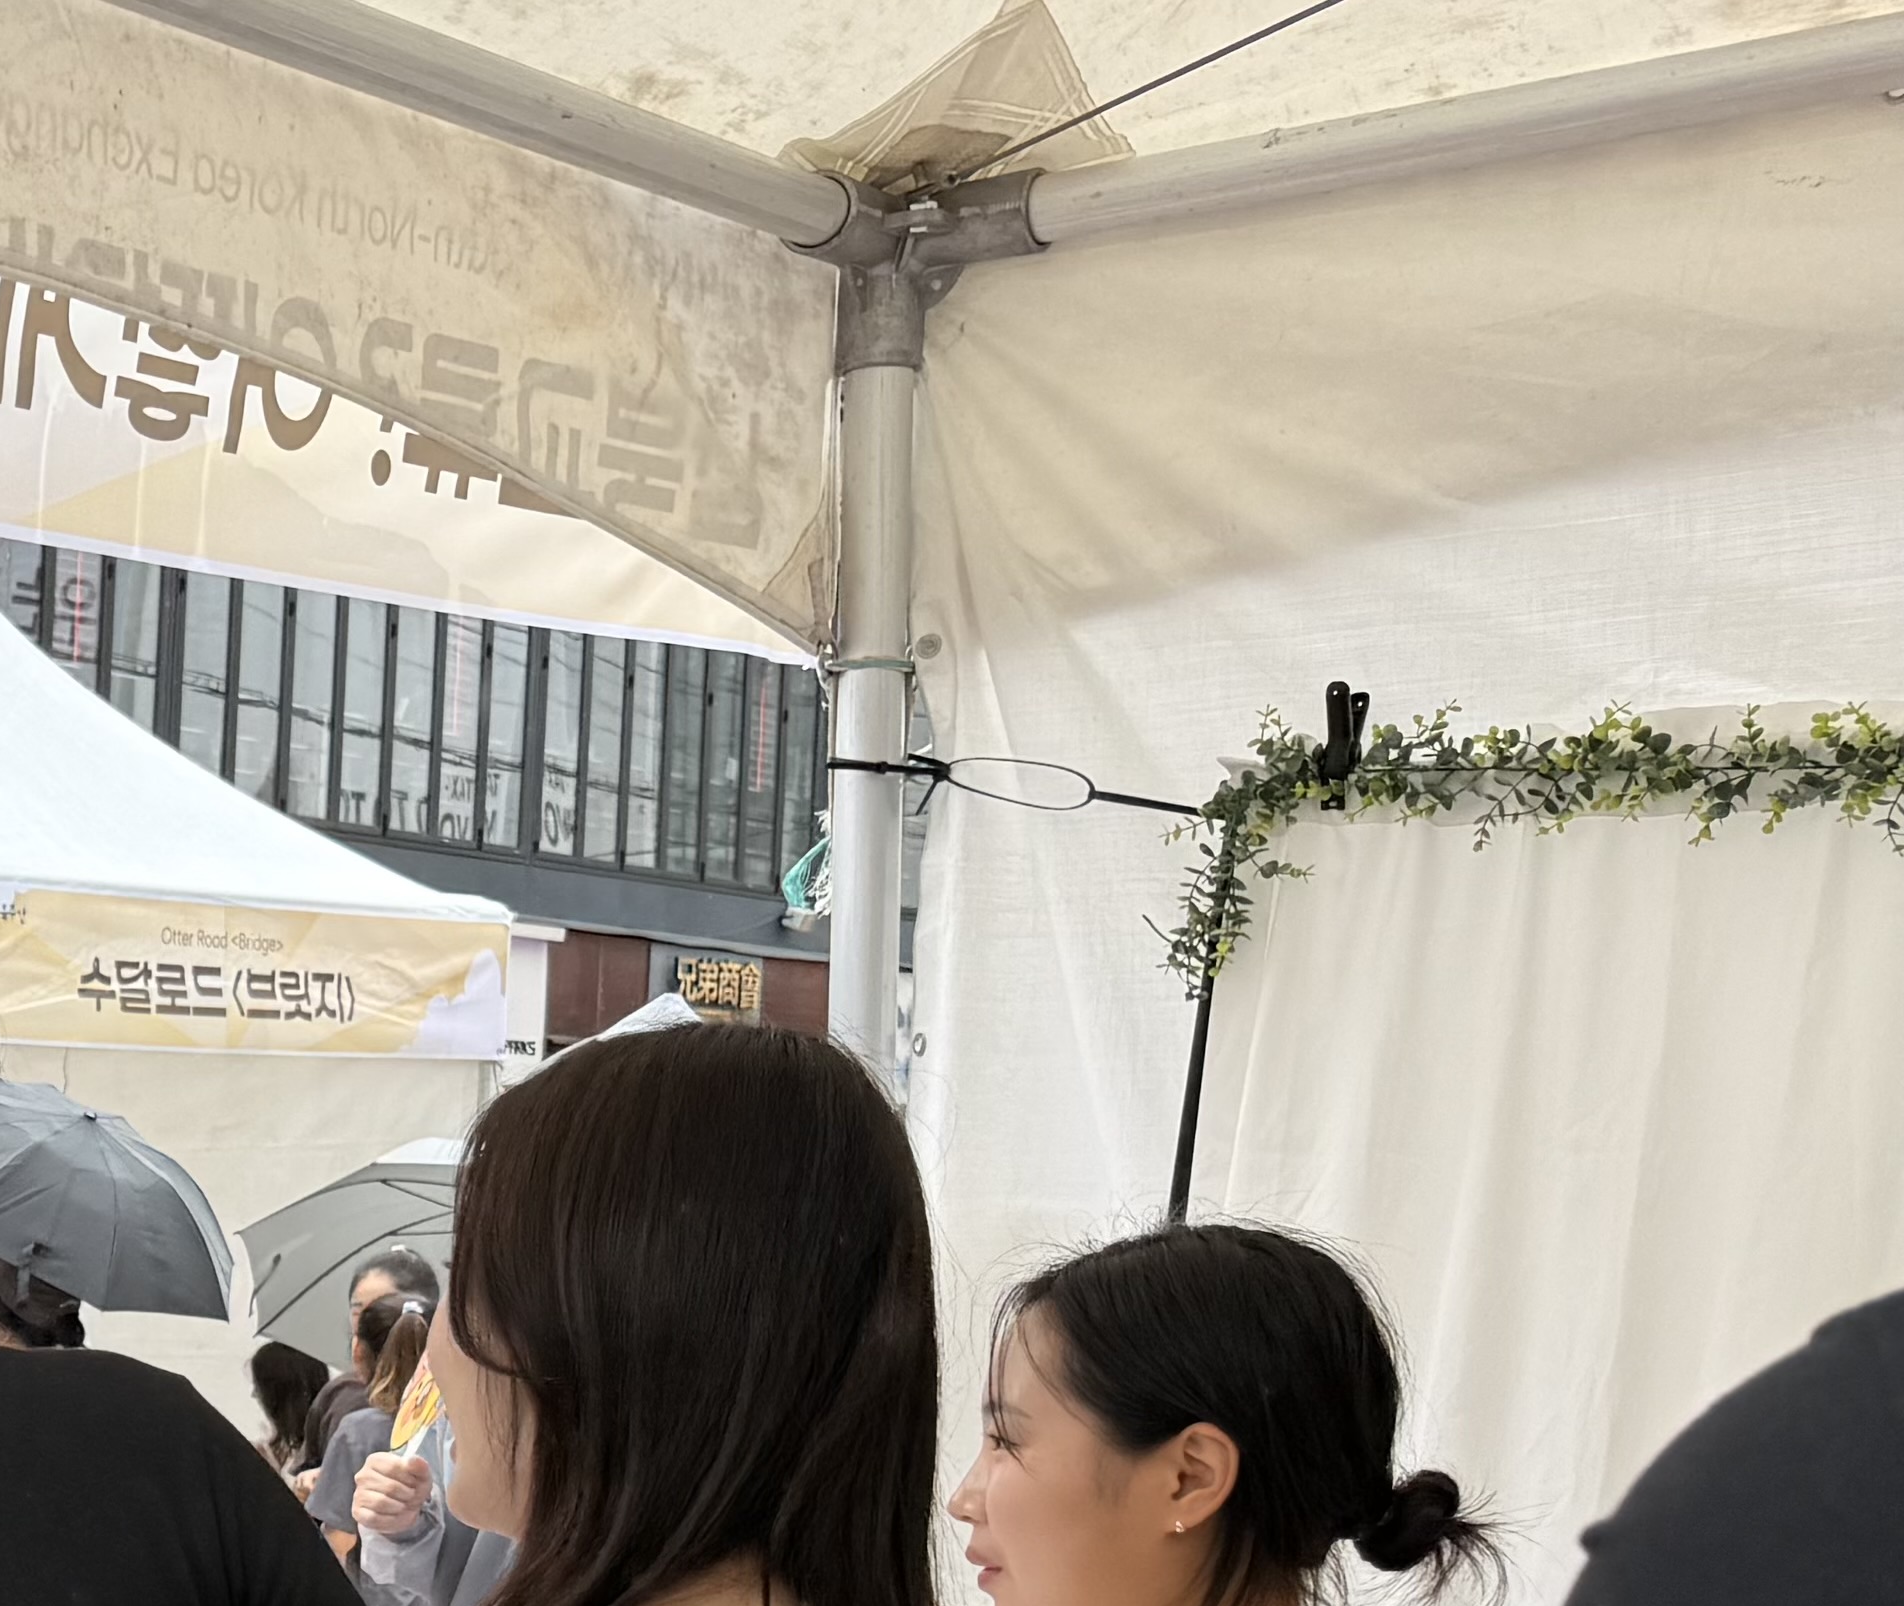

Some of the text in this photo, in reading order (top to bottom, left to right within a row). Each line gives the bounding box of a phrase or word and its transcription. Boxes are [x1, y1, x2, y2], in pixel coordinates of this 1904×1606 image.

[161, 926, 284, 955] Otter Road <Bridge>
